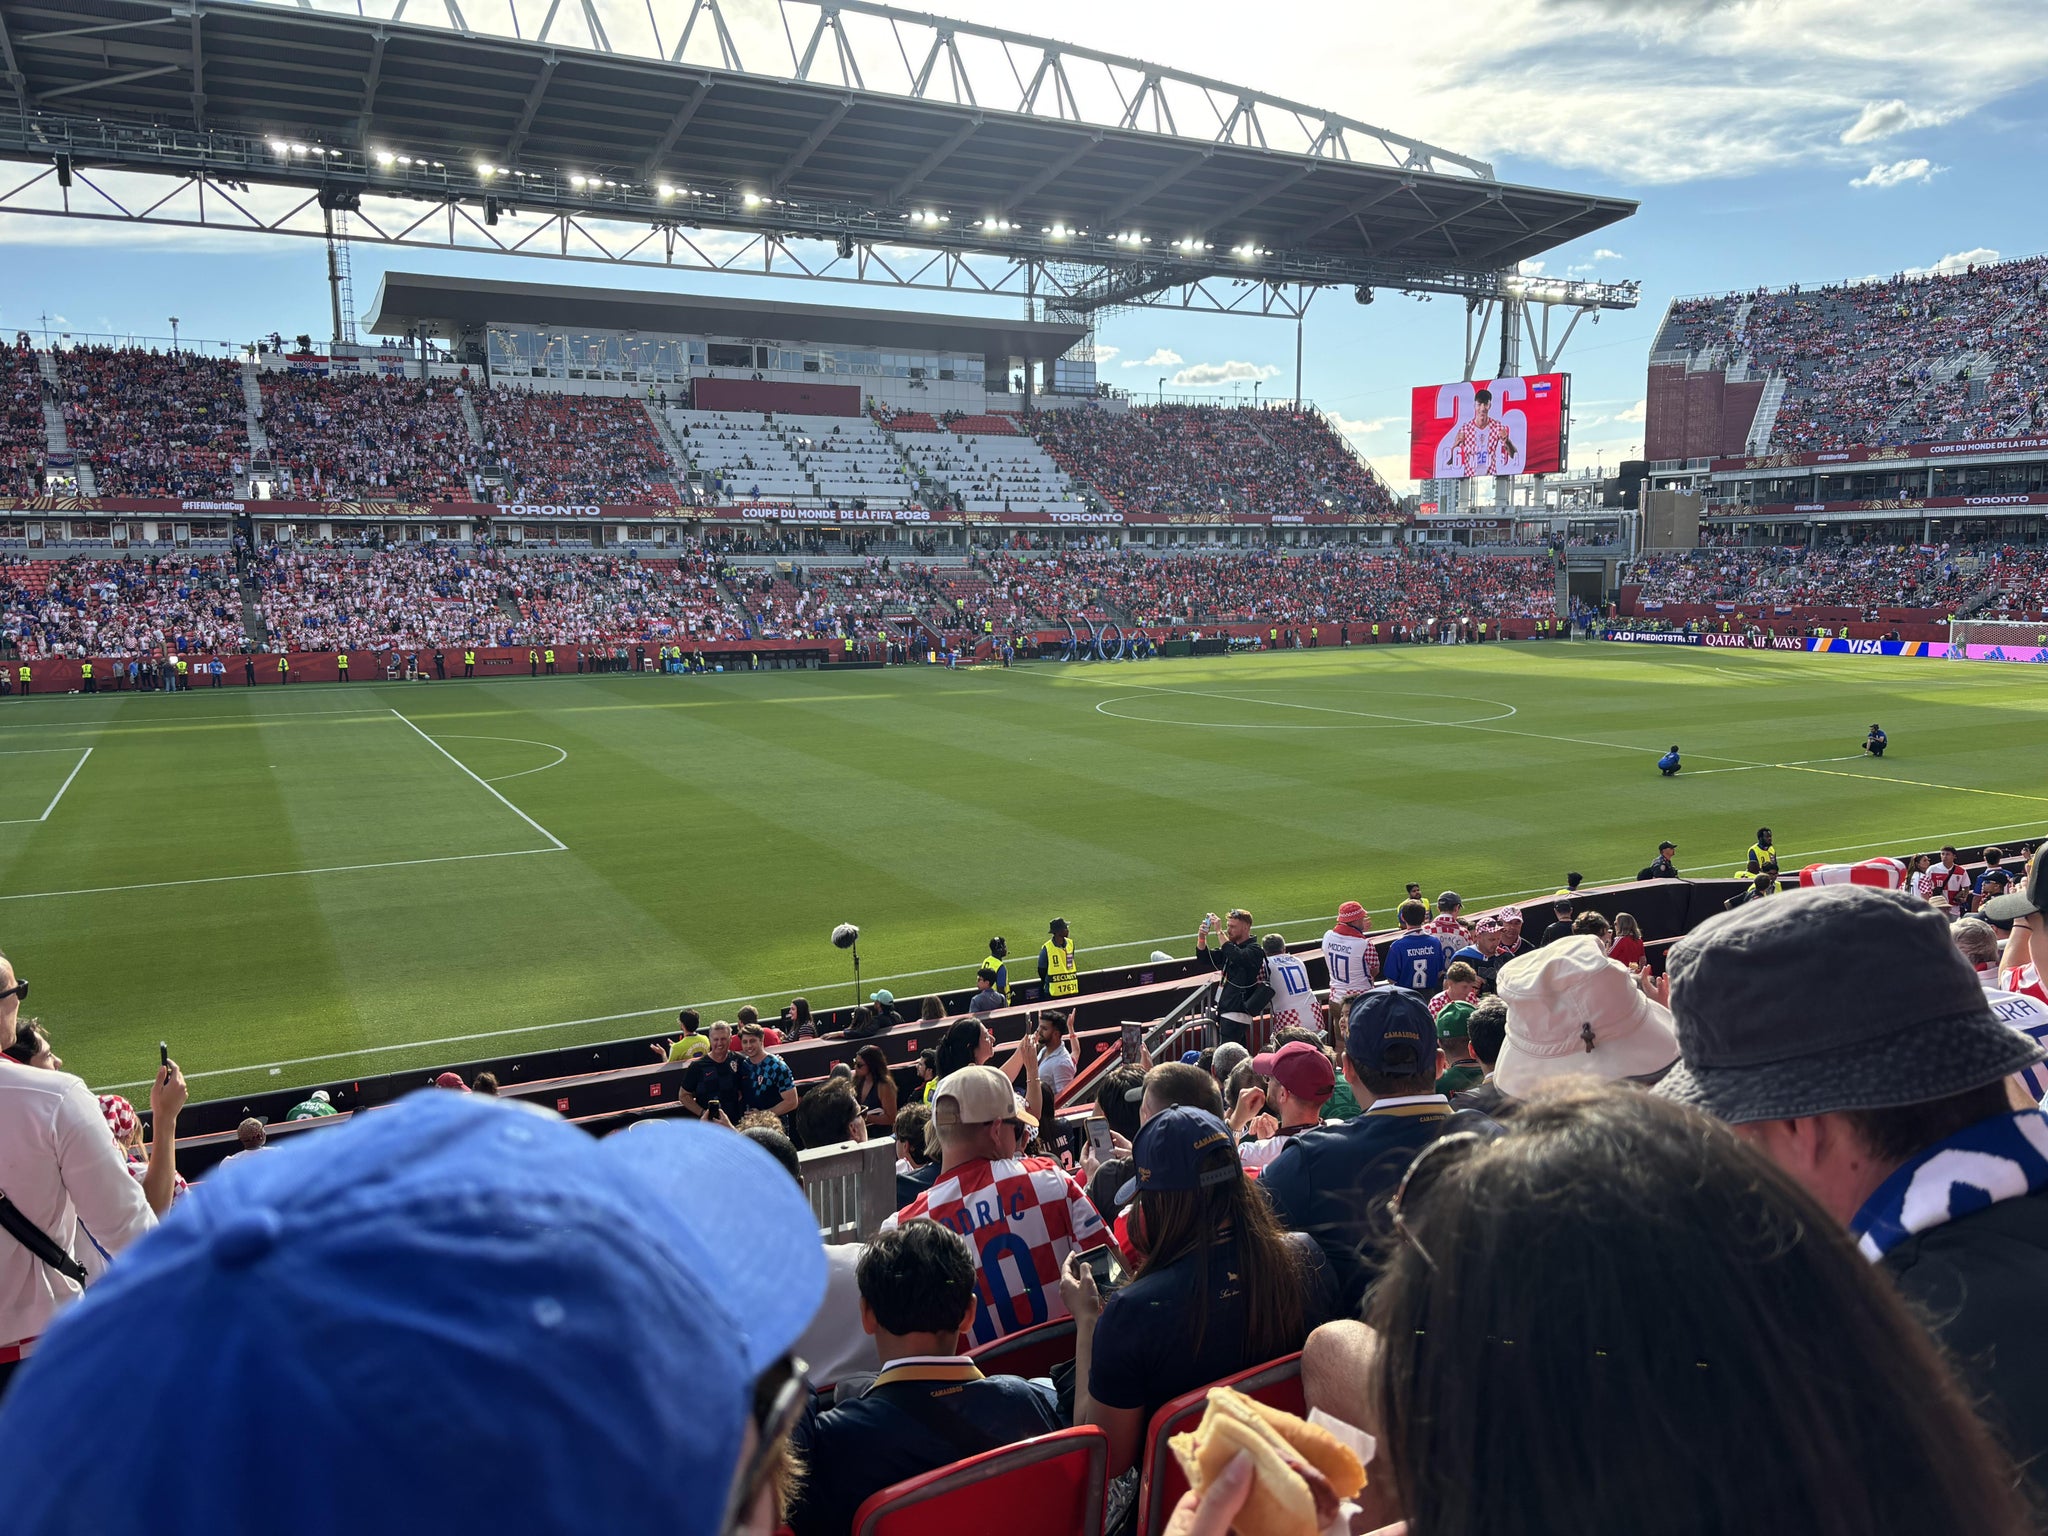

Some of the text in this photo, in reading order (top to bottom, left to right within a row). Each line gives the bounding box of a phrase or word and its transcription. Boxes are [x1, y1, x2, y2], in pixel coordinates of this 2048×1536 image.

[1433, 376, 1528, 479] 26
[1930, 445, 1955, 453] COUPE
[1956, 443, 1967, 451] DU
[1968, 441, 1996, 451] MONDE
[1997, 440, 2008, 449] DE
[2009, 440, 2019, 448] LA
[2020, 439, 2038, 447] FIFA
[1964, 496, 2029, 504] TORONTO
[182, 501, 245, 512] #FIFAWorldCup
[497, 505, 601, 515] TORONTO
[742, 508, 930, 520] COUPE DU MONDE DE LA FIFA 2026
[1049, 513, 1124, 522] TORONTO
[1428, 520, 1497, 528] TORONTO
[1613, 632, 1634, 641] ADI
[1706, 634, 1745, 647] QATAR
[1845, 640, 1882, 654] VISA
[1328, 952, 1350, 984] 10
[1412, 959, 1428, 988] 8
[1052, 973, 1077, 982] SECURITY
[1278, 965, 1308, 995] 10
